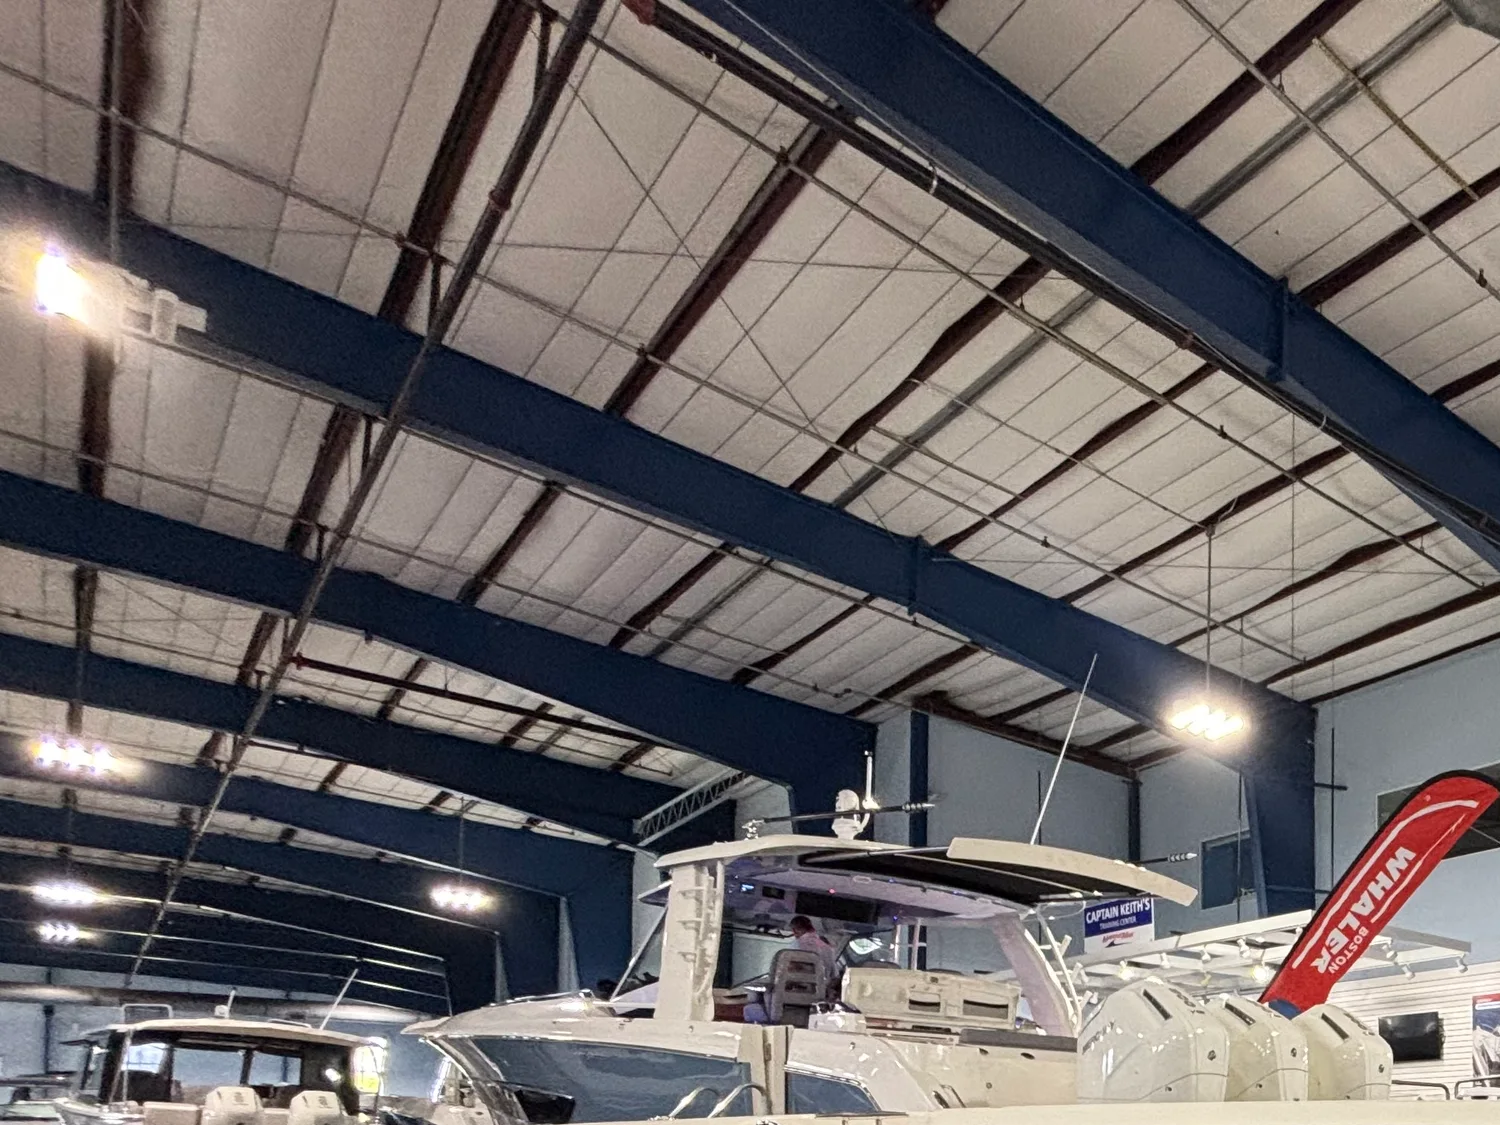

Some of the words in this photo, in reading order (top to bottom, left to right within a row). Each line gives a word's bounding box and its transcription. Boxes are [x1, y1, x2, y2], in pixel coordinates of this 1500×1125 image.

[1086, 906, 1119, 924] CAPTAIN
[1120, 898, 1151, 915] KEITH'S
[1310, 846, 1417, 974] WHALER
[1328, 926, 1369, 974] BOSTON
